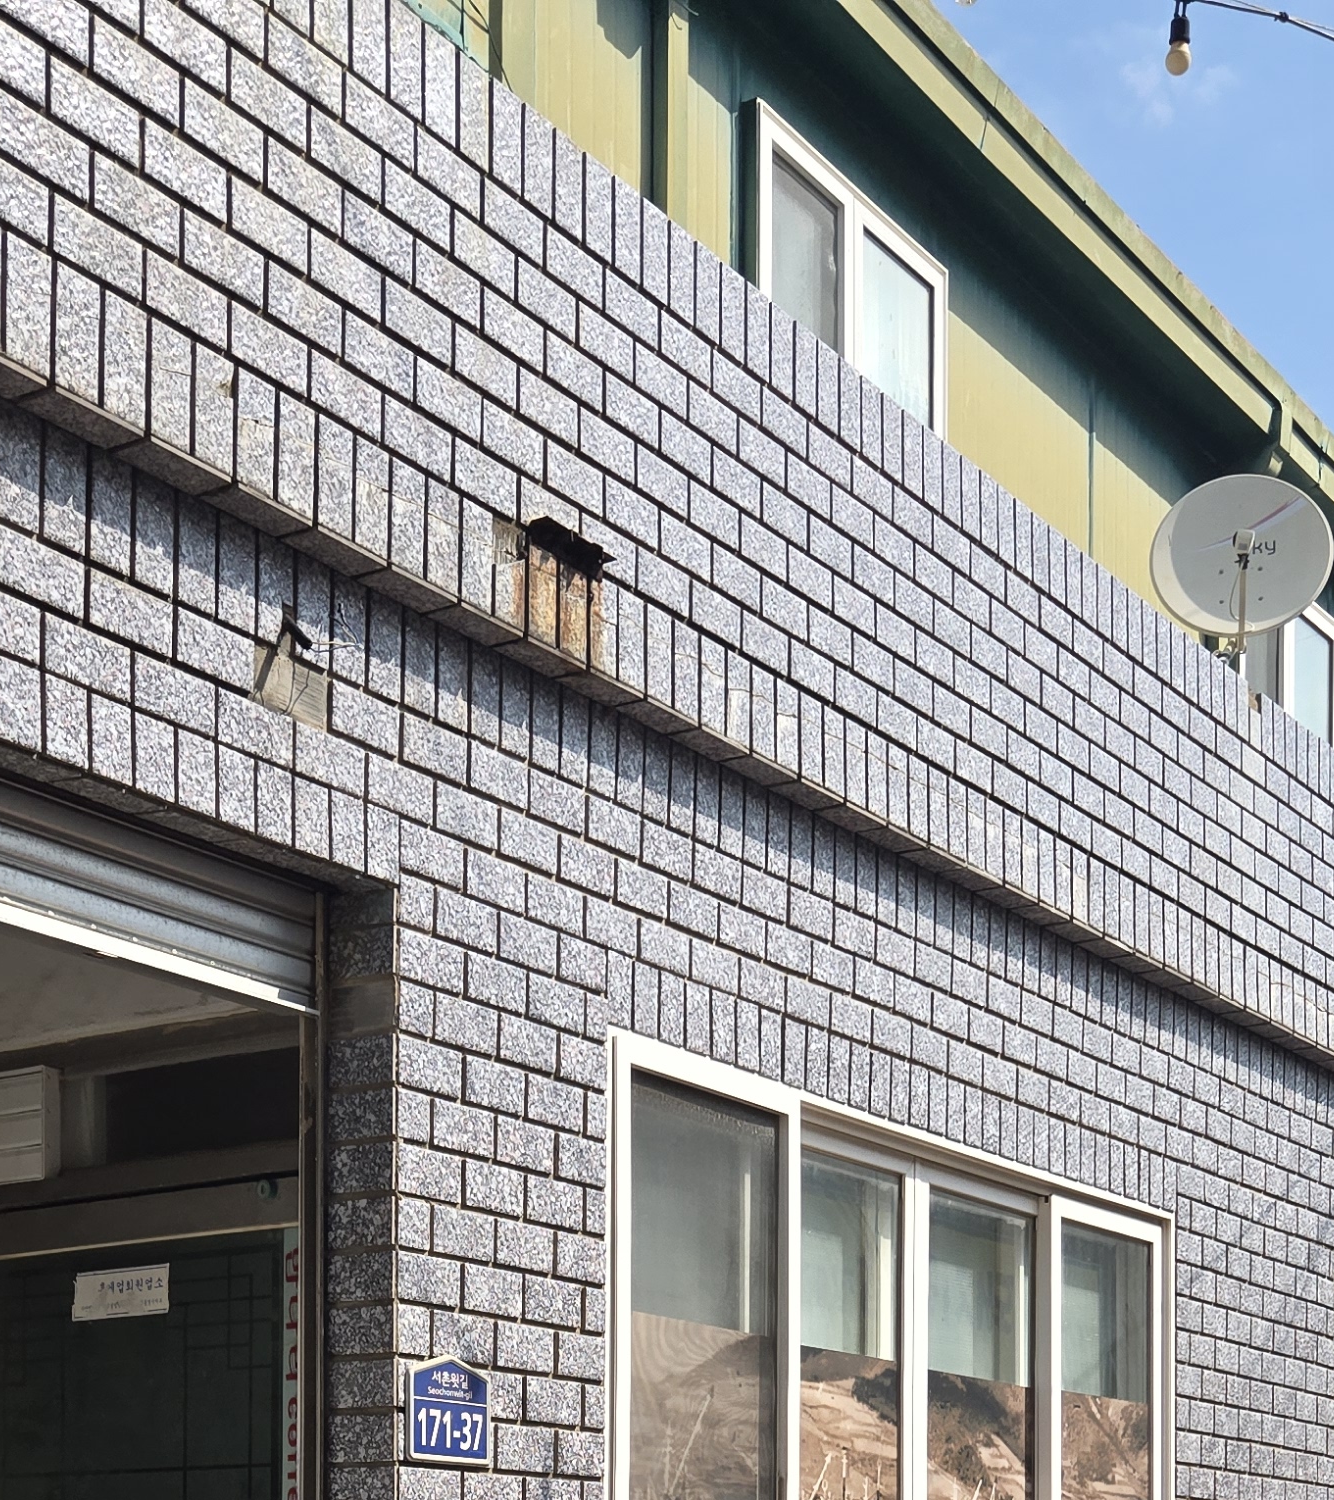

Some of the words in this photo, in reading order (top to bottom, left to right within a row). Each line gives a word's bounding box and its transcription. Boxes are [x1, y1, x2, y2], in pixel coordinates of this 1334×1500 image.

[1252, 539, 1277, 556] ky
[431, 1370, 469, 1390] 서촌윗길
[427, 1386, 473, 1401] Seochonwit-gil
[417, 1407, 484, 1452] 171-37
